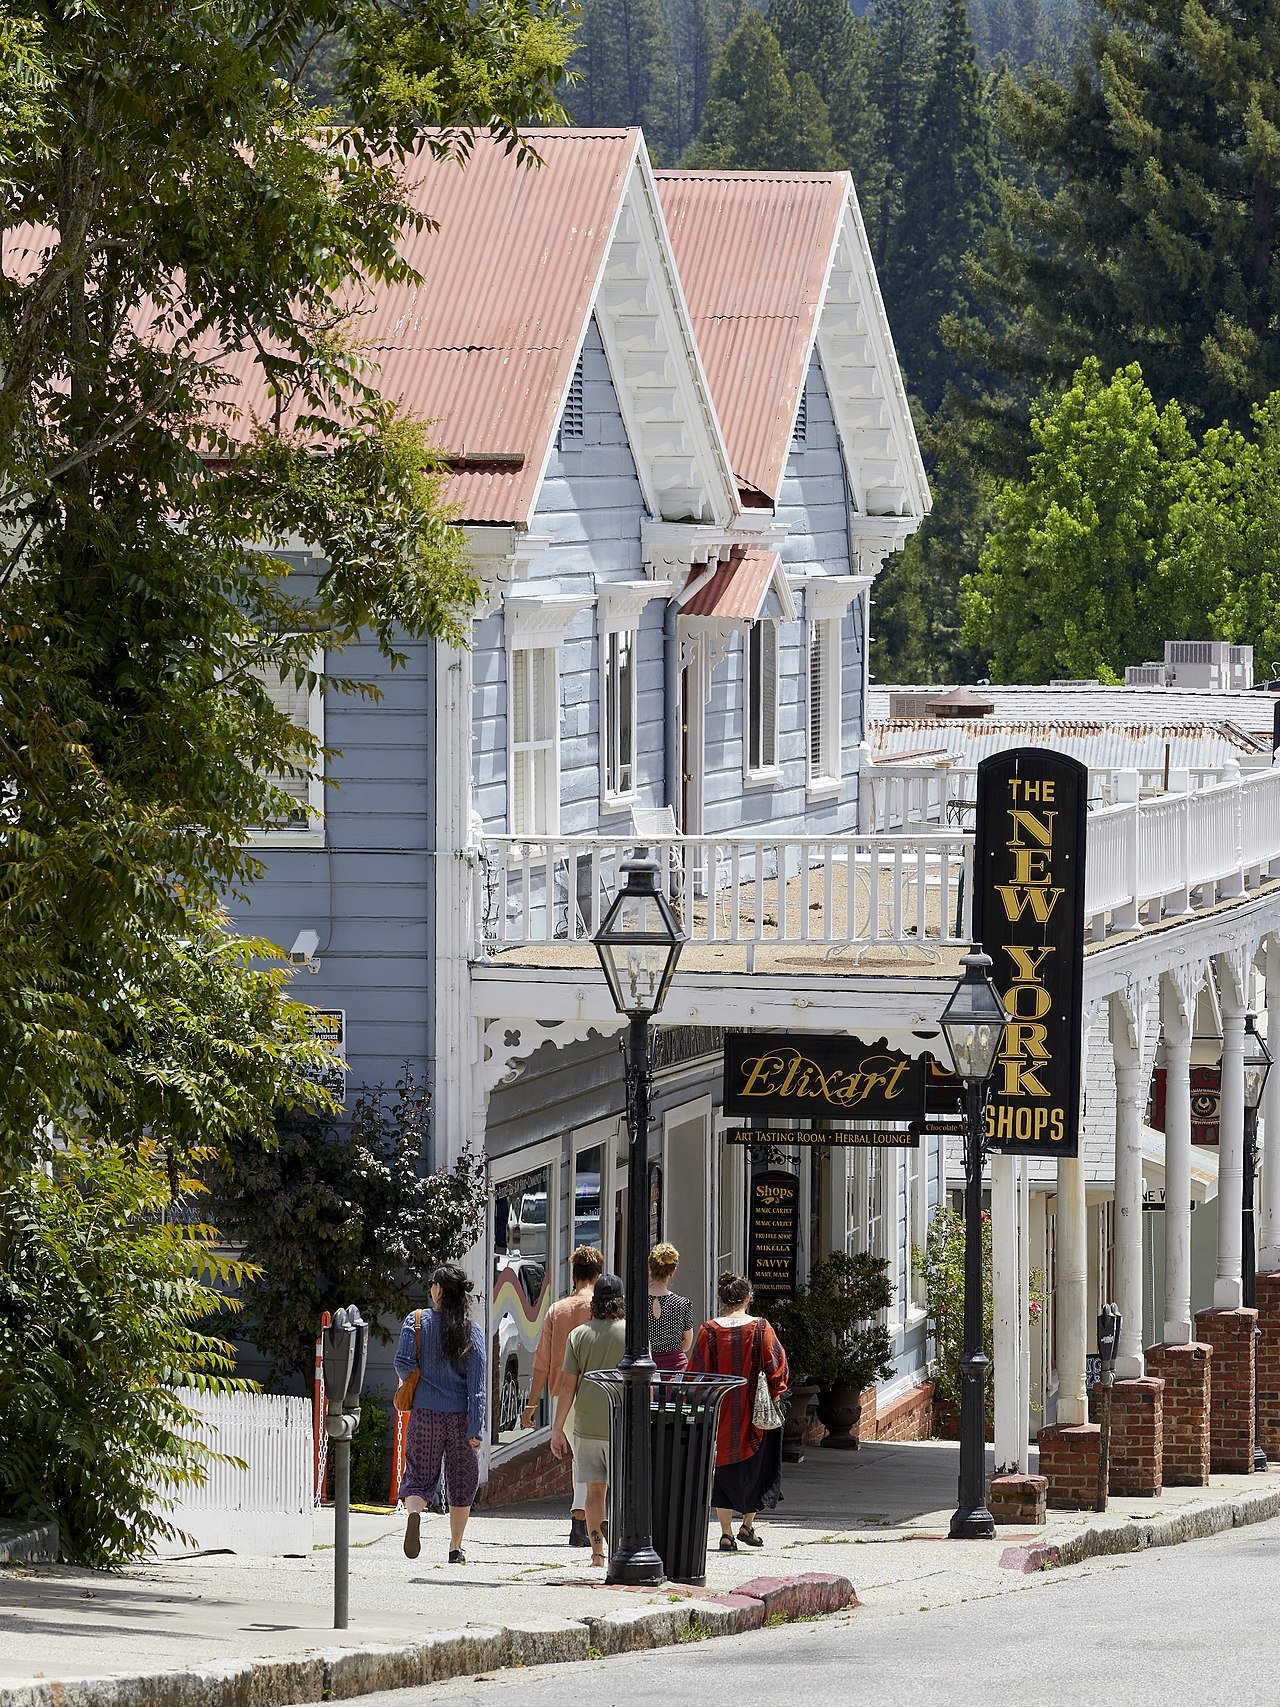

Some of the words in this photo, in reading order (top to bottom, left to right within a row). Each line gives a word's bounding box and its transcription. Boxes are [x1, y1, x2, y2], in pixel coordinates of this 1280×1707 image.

[1008, 778, 1055, 802] THE
[993, 809, 1065, 923] NEW
[998, 945, 1057, 1097] YORK
[737, 1047, 910, 1108] Elixart
[925, 1123, 957, 1132] Chocolate
[983, 1103, 1064, 1141] SHOPS
[734, 1130, 754, 1141] ART
[755, 1131, 794, 1142] TASTING
[797, 1132, 826, 1143] ROOM
[835, 1132, 871, 1143] HERBAL
[873, 1133, 912, 1144] LOUNGE
[756, 1184, 794, 1199] Shops
[756, 1259, 790, 1268] SAVVY
